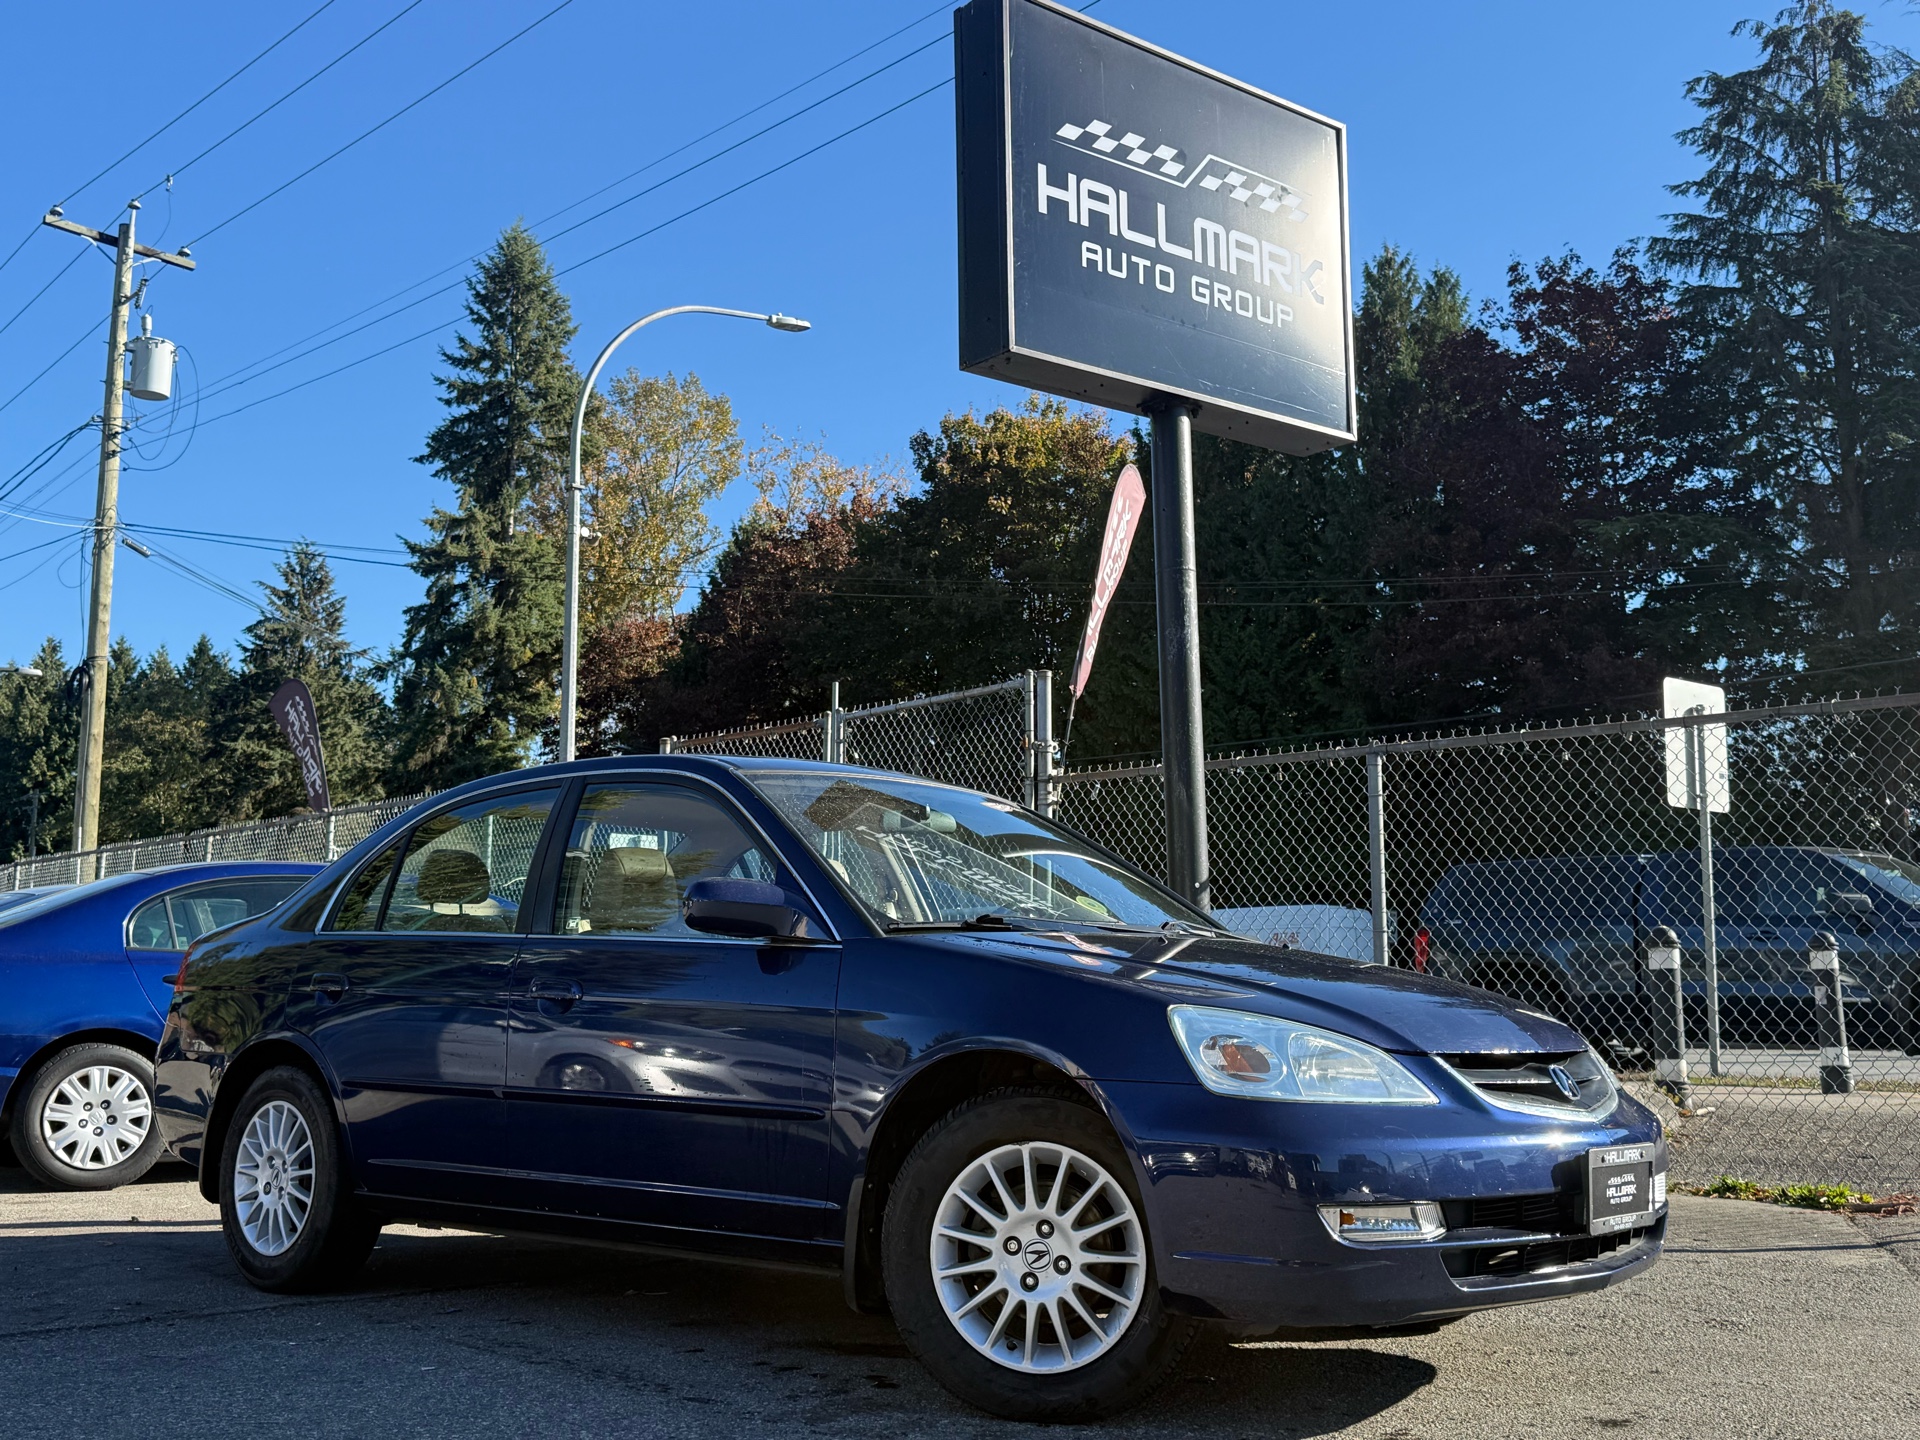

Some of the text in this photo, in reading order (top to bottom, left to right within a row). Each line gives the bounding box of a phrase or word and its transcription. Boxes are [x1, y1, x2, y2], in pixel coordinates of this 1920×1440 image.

[1037, 162, 1325, 305] HALLMARK
[1081, 240, 1294, 328] AUTO GROUP
[1605, 1149, 1640, 1163] HALLMARK
[1606, 1184, 1637, 1198] HALLMARK
